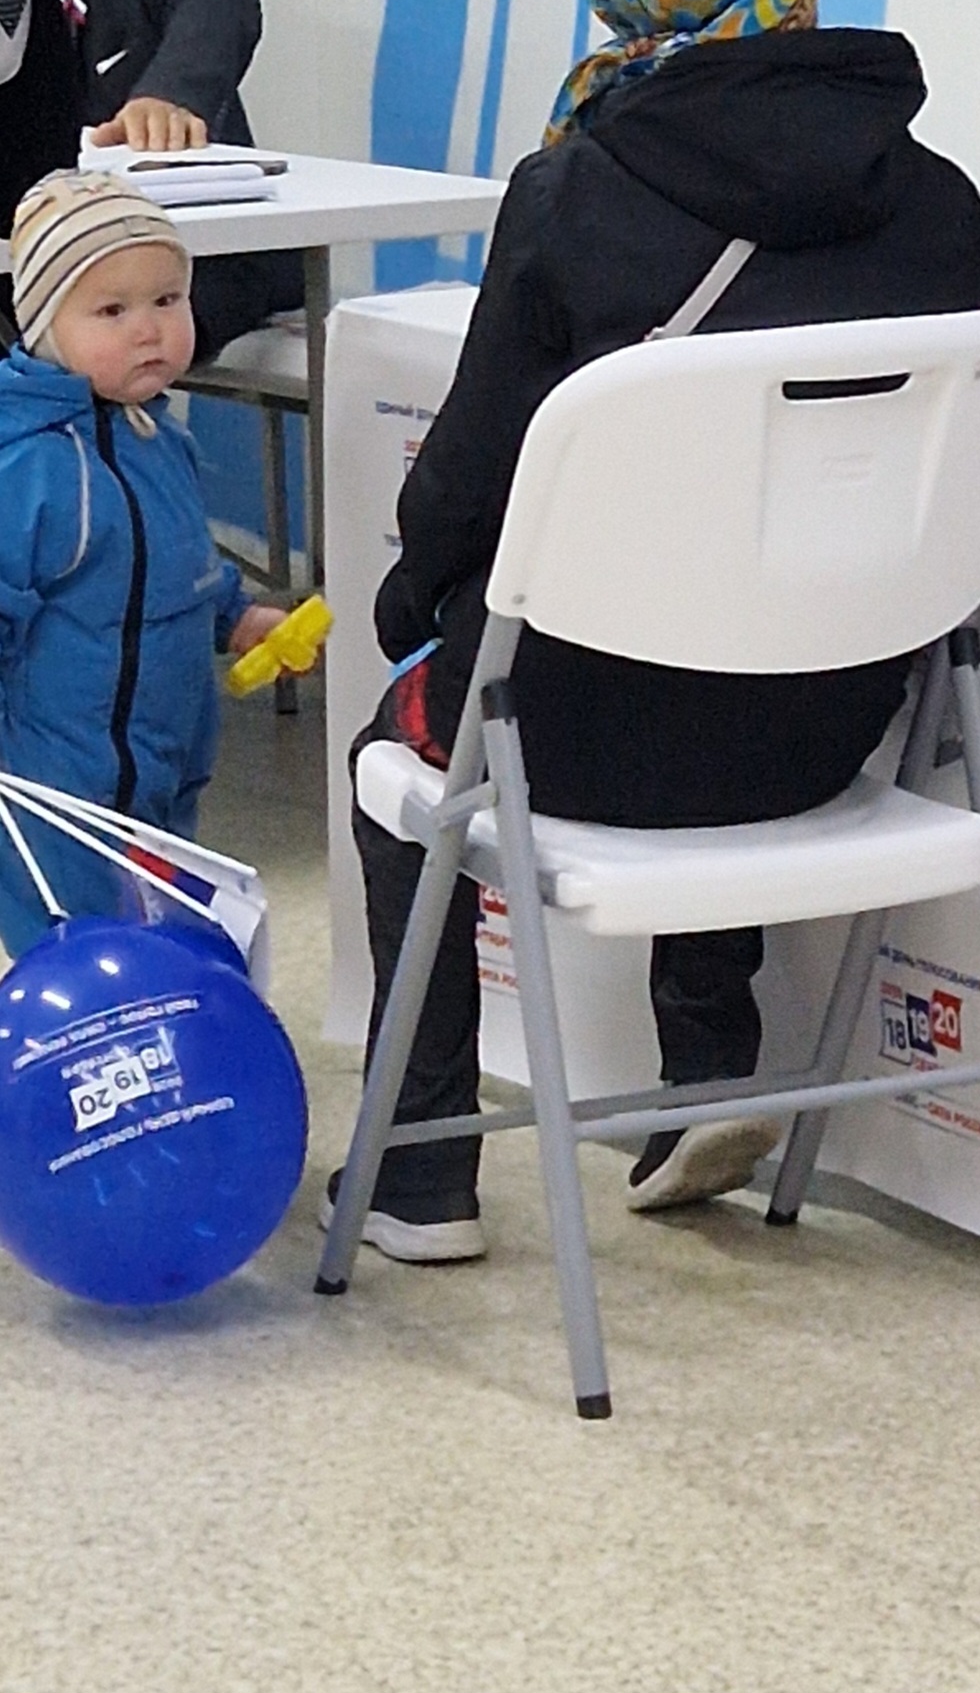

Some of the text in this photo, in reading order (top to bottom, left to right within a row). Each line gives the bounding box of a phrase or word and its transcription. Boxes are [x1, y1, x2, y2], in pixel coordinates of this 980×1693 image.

[884, 1001, 958, 1050] 18 19 20
[114, 1070, 142, 1090] 19
[79, 1088, 113, 1115] 20
